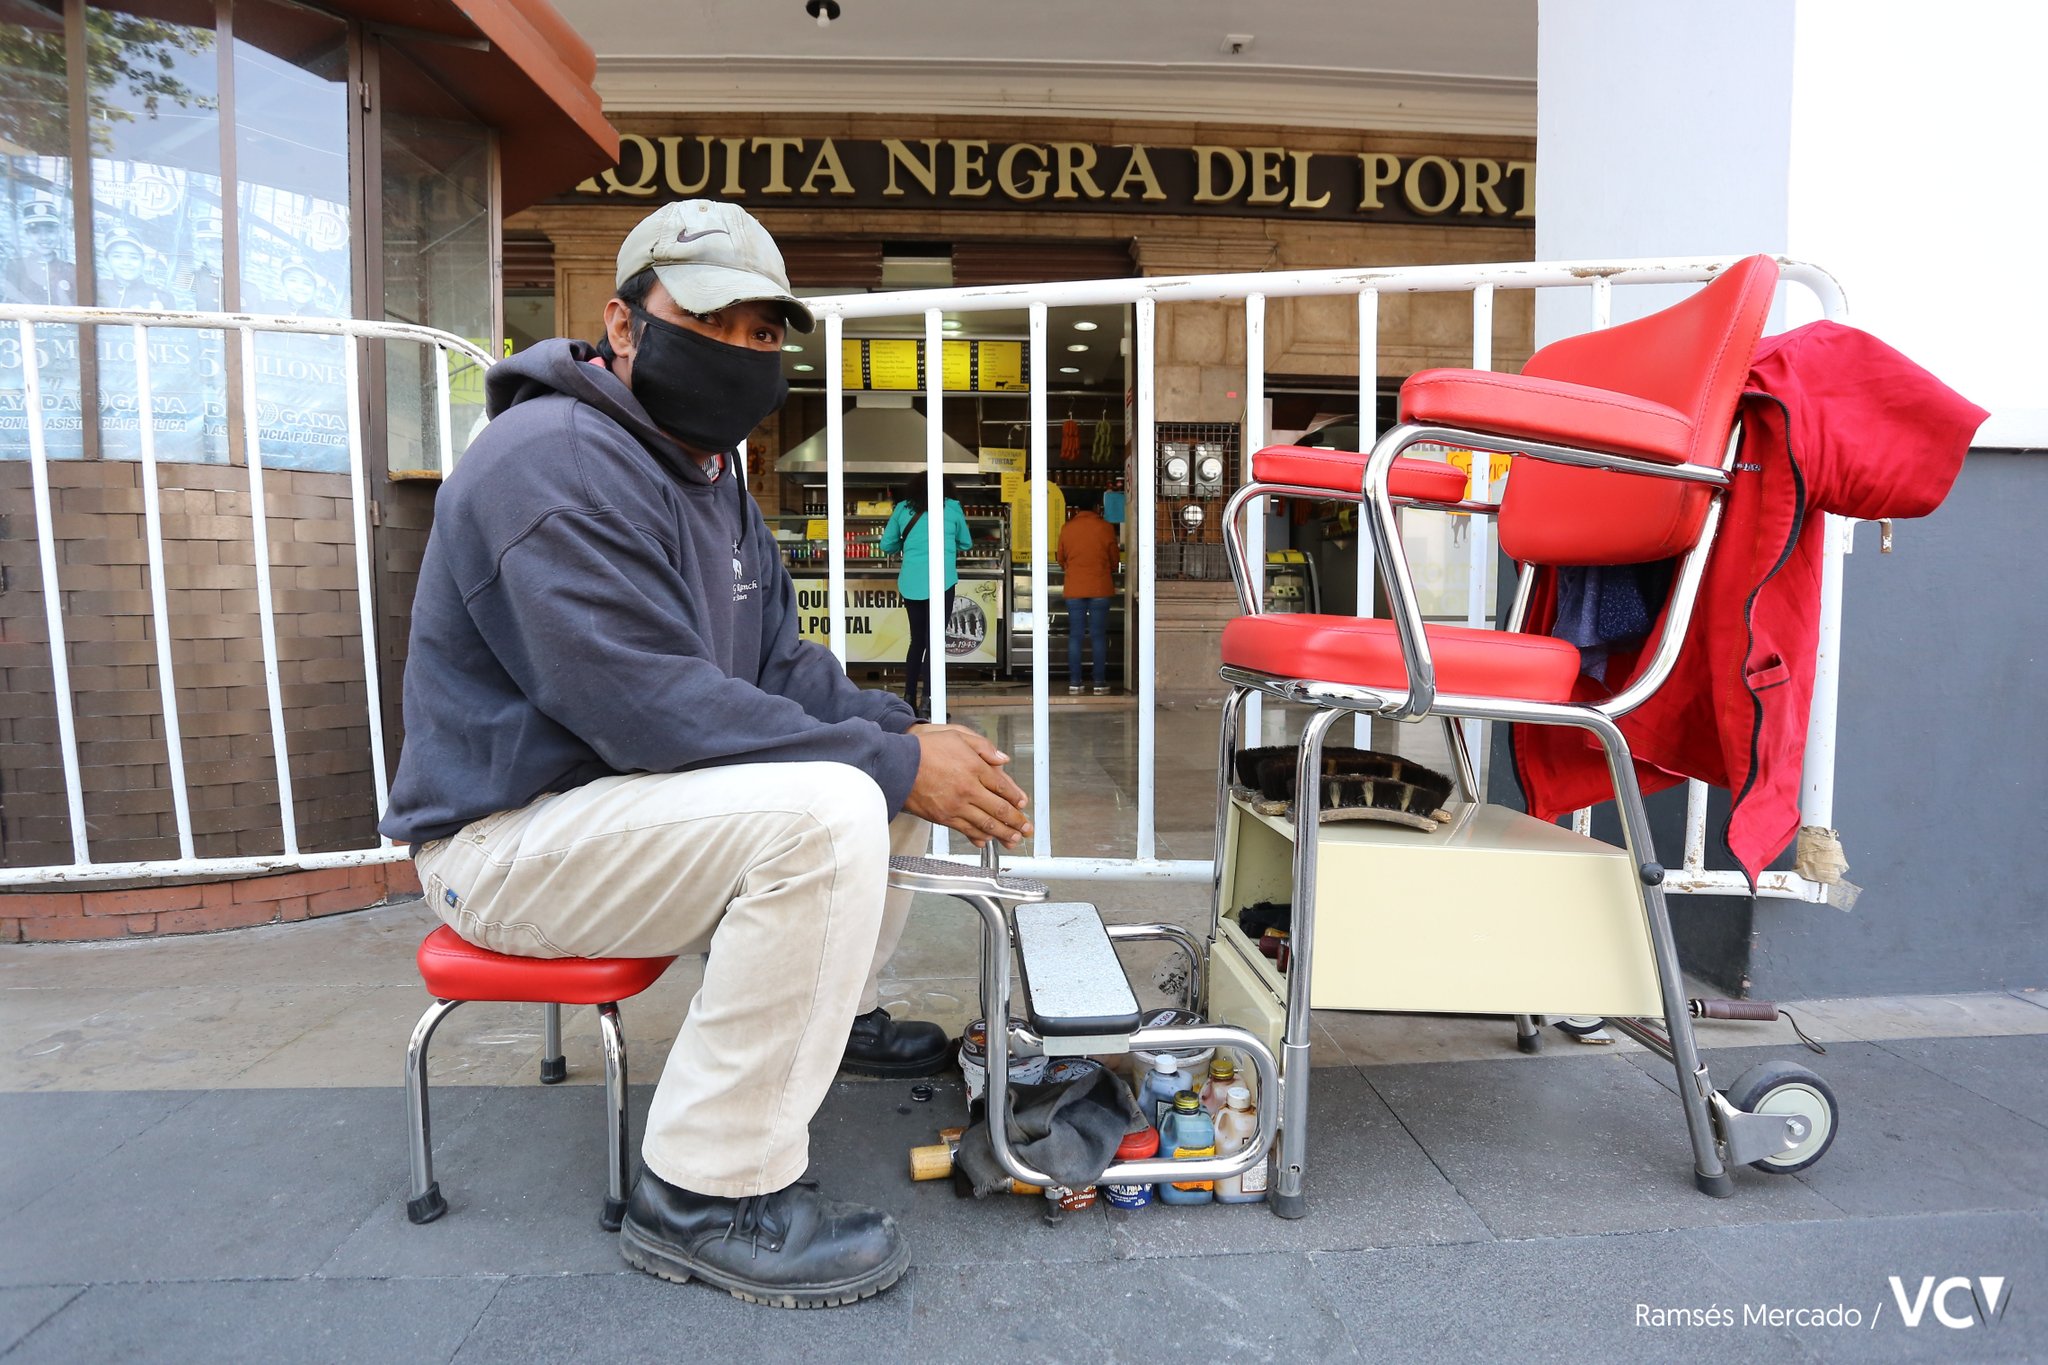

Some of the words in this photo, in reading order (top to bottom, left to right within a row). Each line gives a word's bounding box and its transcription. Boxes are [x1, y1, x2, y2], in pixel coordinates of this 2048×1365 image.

[576, 134, 856, 197] QUITA
[881, 137, 1168, 200] NEGRA
[1192, 145, 1331, 210] DEL
[854, 590, 905, 609] NEGRA
[809, 616, 872, 634] POTAL
